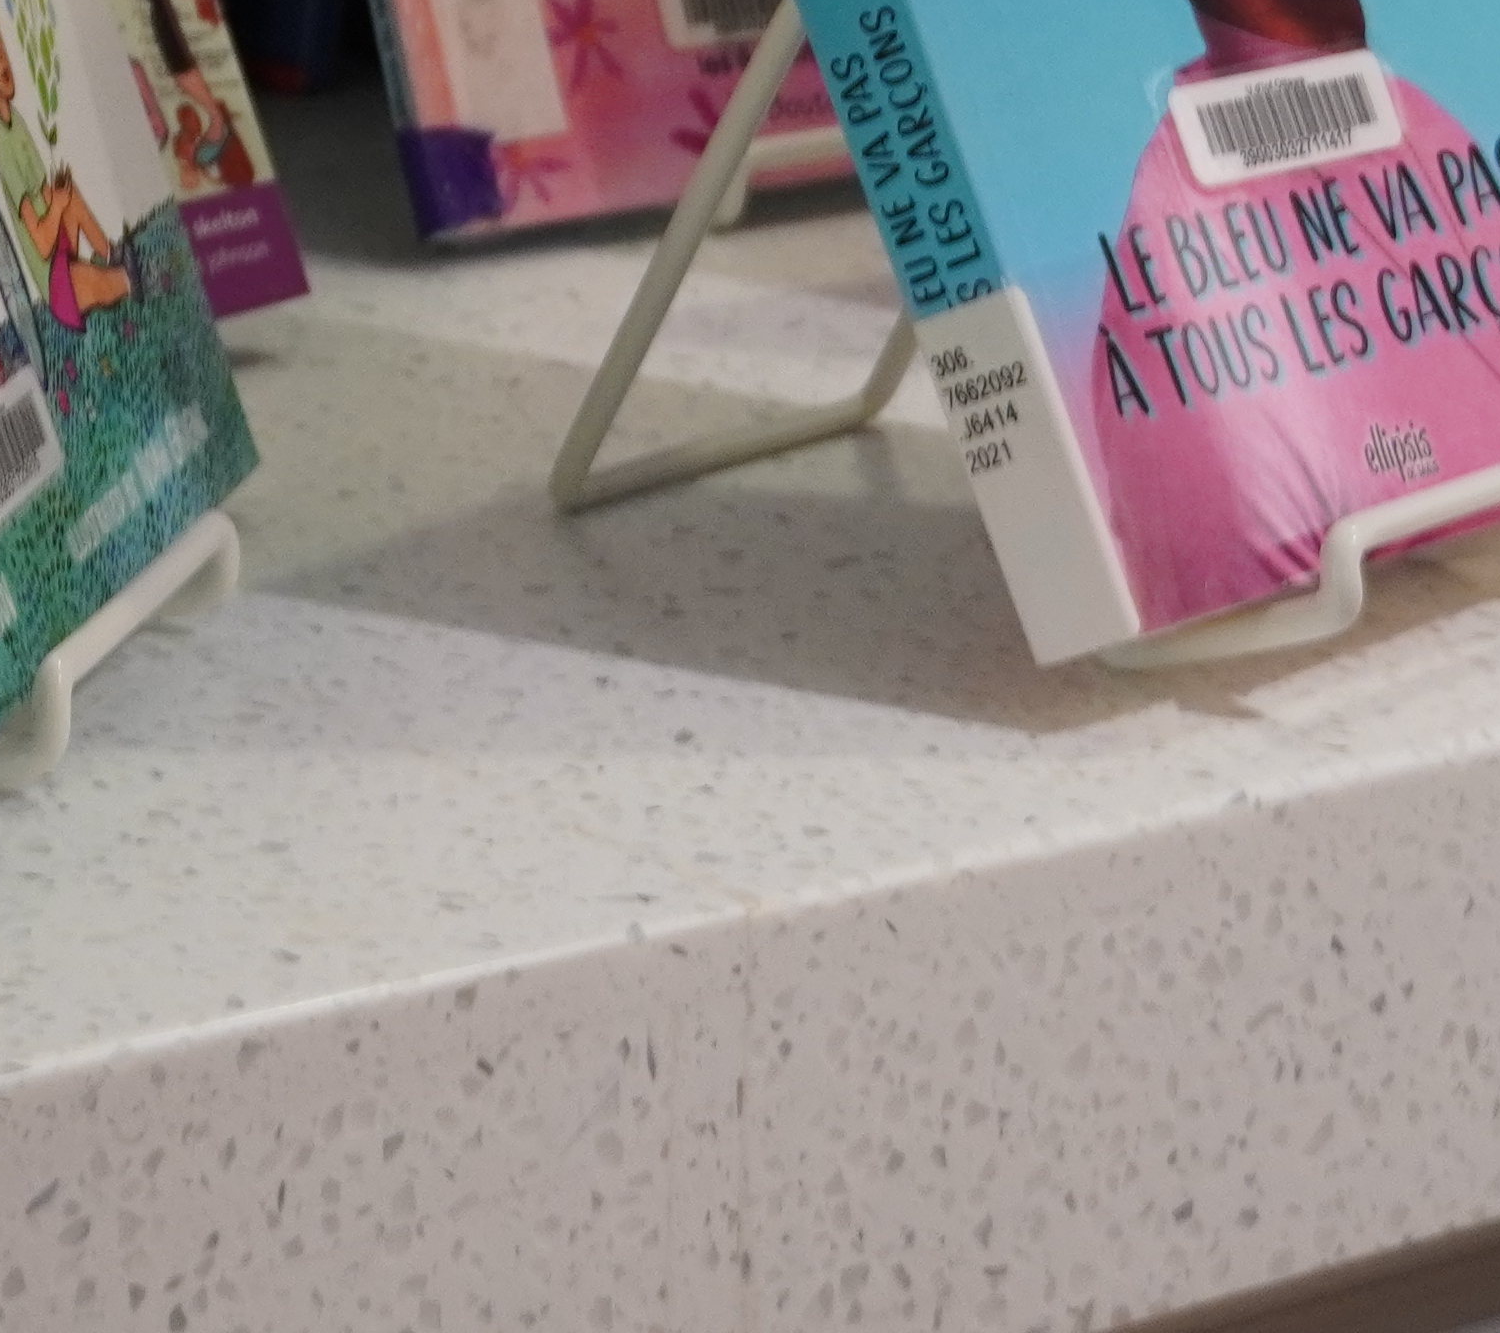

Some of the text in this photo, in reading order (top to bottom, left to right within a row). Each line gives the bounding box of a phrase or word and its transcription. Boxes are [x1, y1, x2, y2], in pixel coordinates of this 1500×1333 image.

[829, 52, 881, 127] PAS
[859, 3, 951, 191] GARÇONS
[863, 130, 903, 189] VA
[881, 201, 925, 248] NE
[926, 196, 981, 266] LES
[1097, 222, 1167, 316] LE
[1165, 196, 1288, 299] BLEU
[1289, 176, 1361, 263] NE
[1359, 158, 1438, 242] VA
[1097, 321, 1150, 419] À
[1144, 299, 1280, 409] TOUS
[1279, 277, 1370, 374] LES
[942, 360, 1028, 413] 7662092
[965, 439, 1013, 475] 2021
